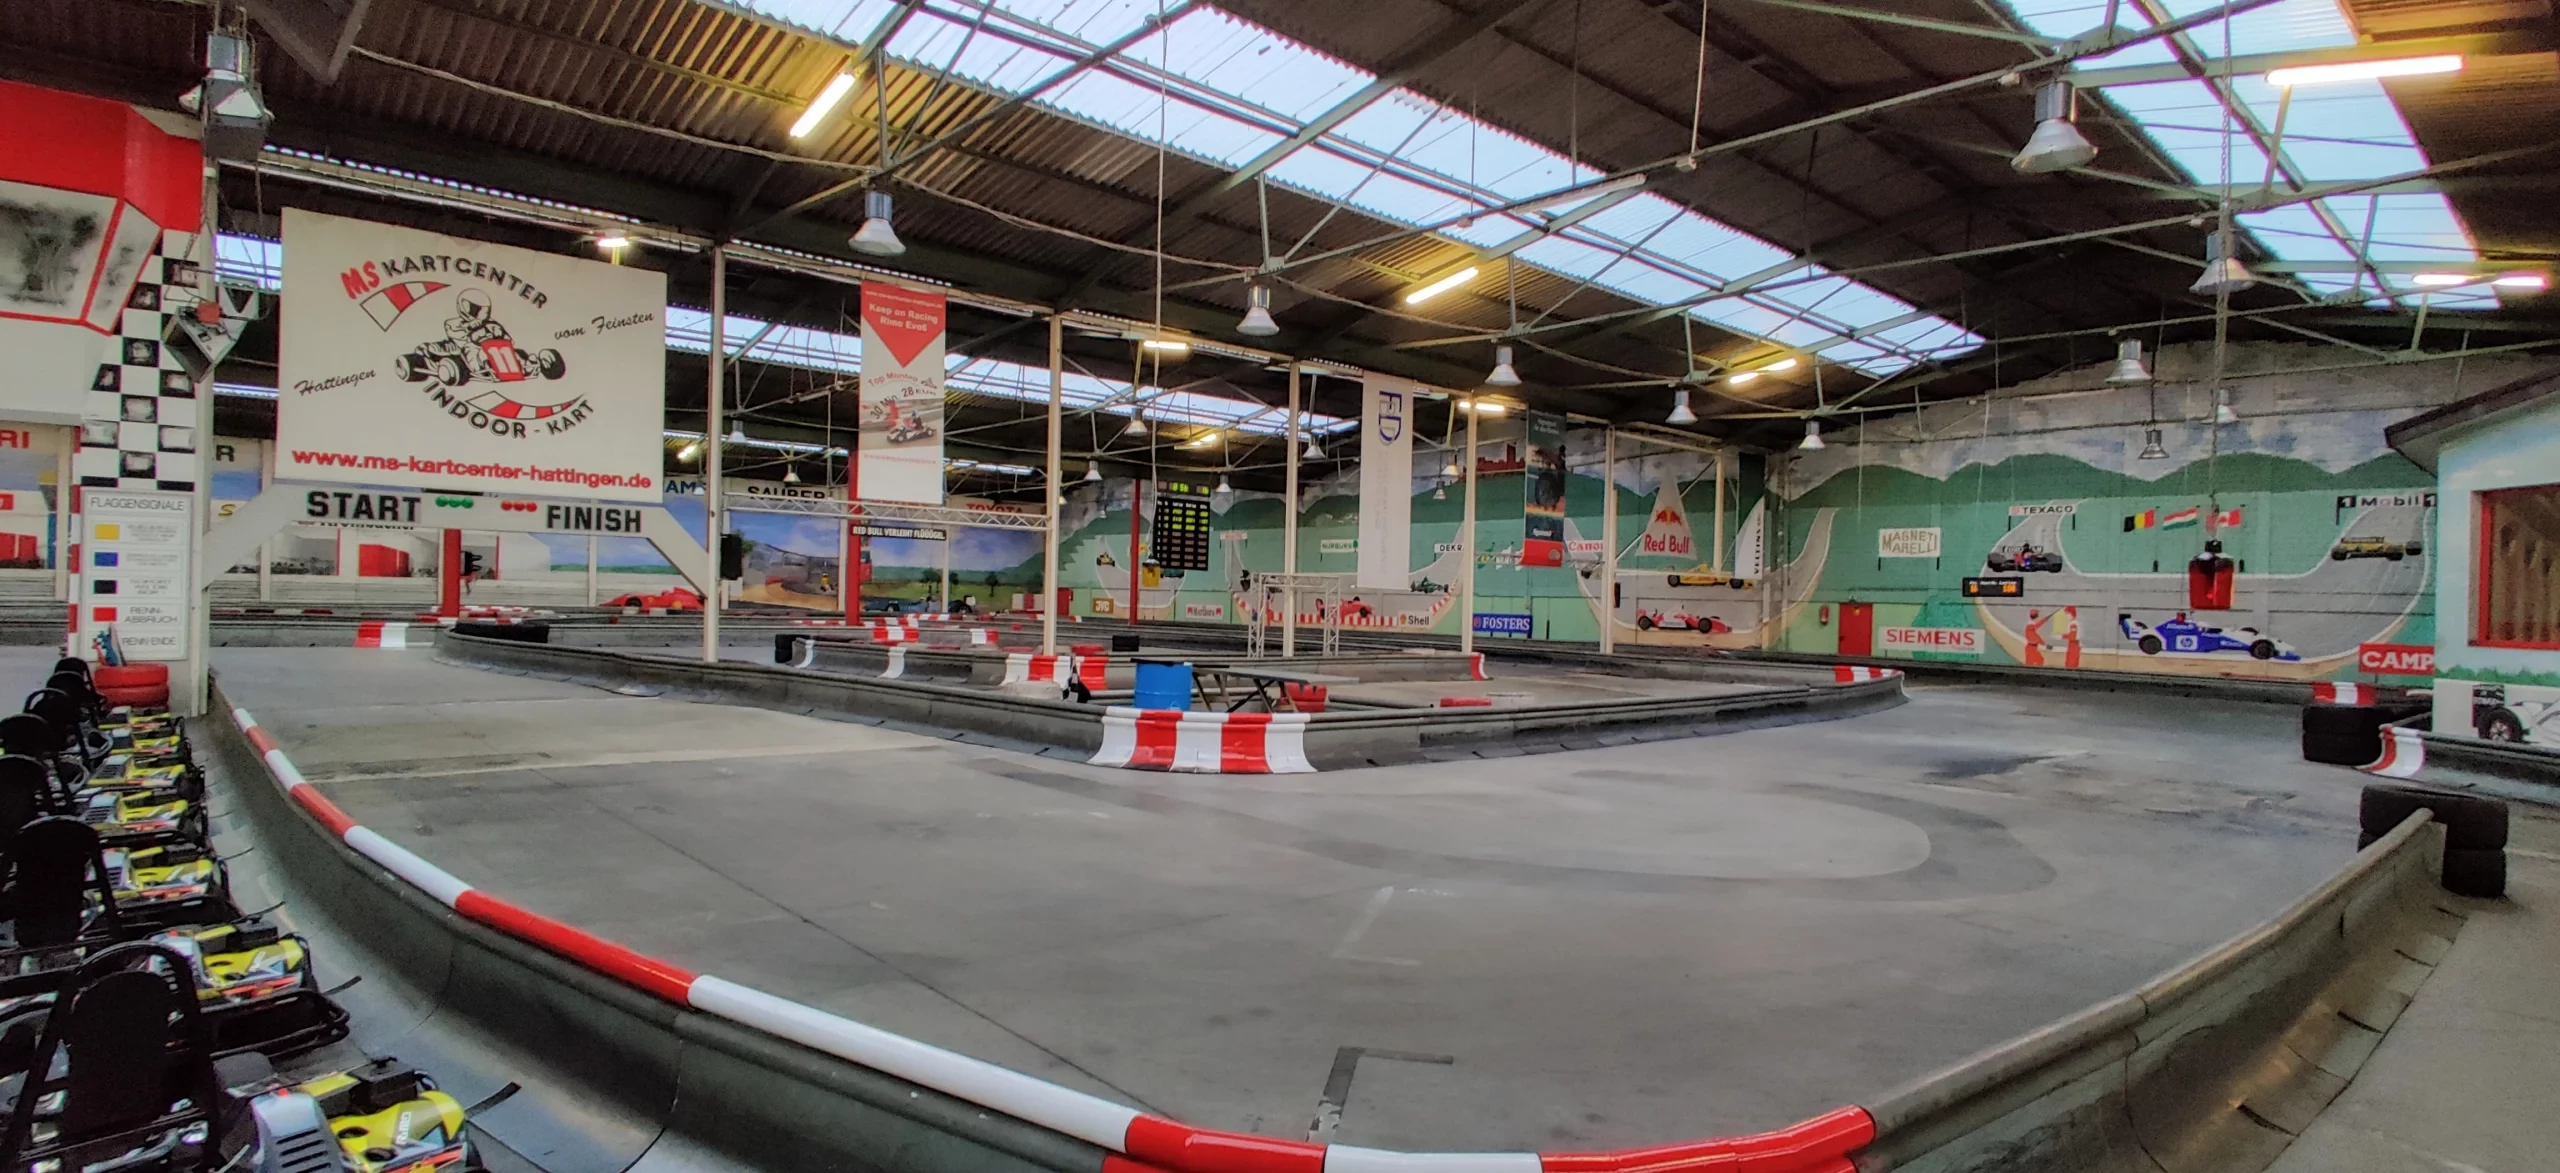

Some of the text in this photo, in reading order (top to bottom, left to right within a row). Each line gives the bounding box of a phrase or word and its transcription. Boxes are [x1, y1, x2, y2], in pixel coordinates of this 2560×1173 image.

[340, 255, 548, 310] MS KARTCENTER
[869, 303, 938, 325] Keep on Racing
[880, 316, 903, 328] Rimo
[554, 313, 654, 340] vom Feinsten
[293, 371, 376, 397] Hattingen
[868, 376, 885, 386] Top
[423, 381, 526, 439] INDOOR
[547, 400, 595, 435] KART
[292, 450, 652, 489] www.ms-kartcenter-hattingen.de
[91, 497, 184, 511] FLAGGENSIGNALE
[2361, 496, 2419, 506] Mobil
[307, 490, 642, 533] START FINISH
[853, 526, 866, 535] RED
[868, 527, 883, 536] BULL
[884, 528, 912, 538] VERLEIHT
[1882, 530, 1938, 545] MAGNETI
[1644, 534, 1689, 554] Red Bull
[1882, 541, 1938, 555] MARELLI
[1407, 615, 1430, 625] Shell
[1482, 616, 1531, 630] FOSTERS
[1886, 629, 1975, 646] SIEMENS
